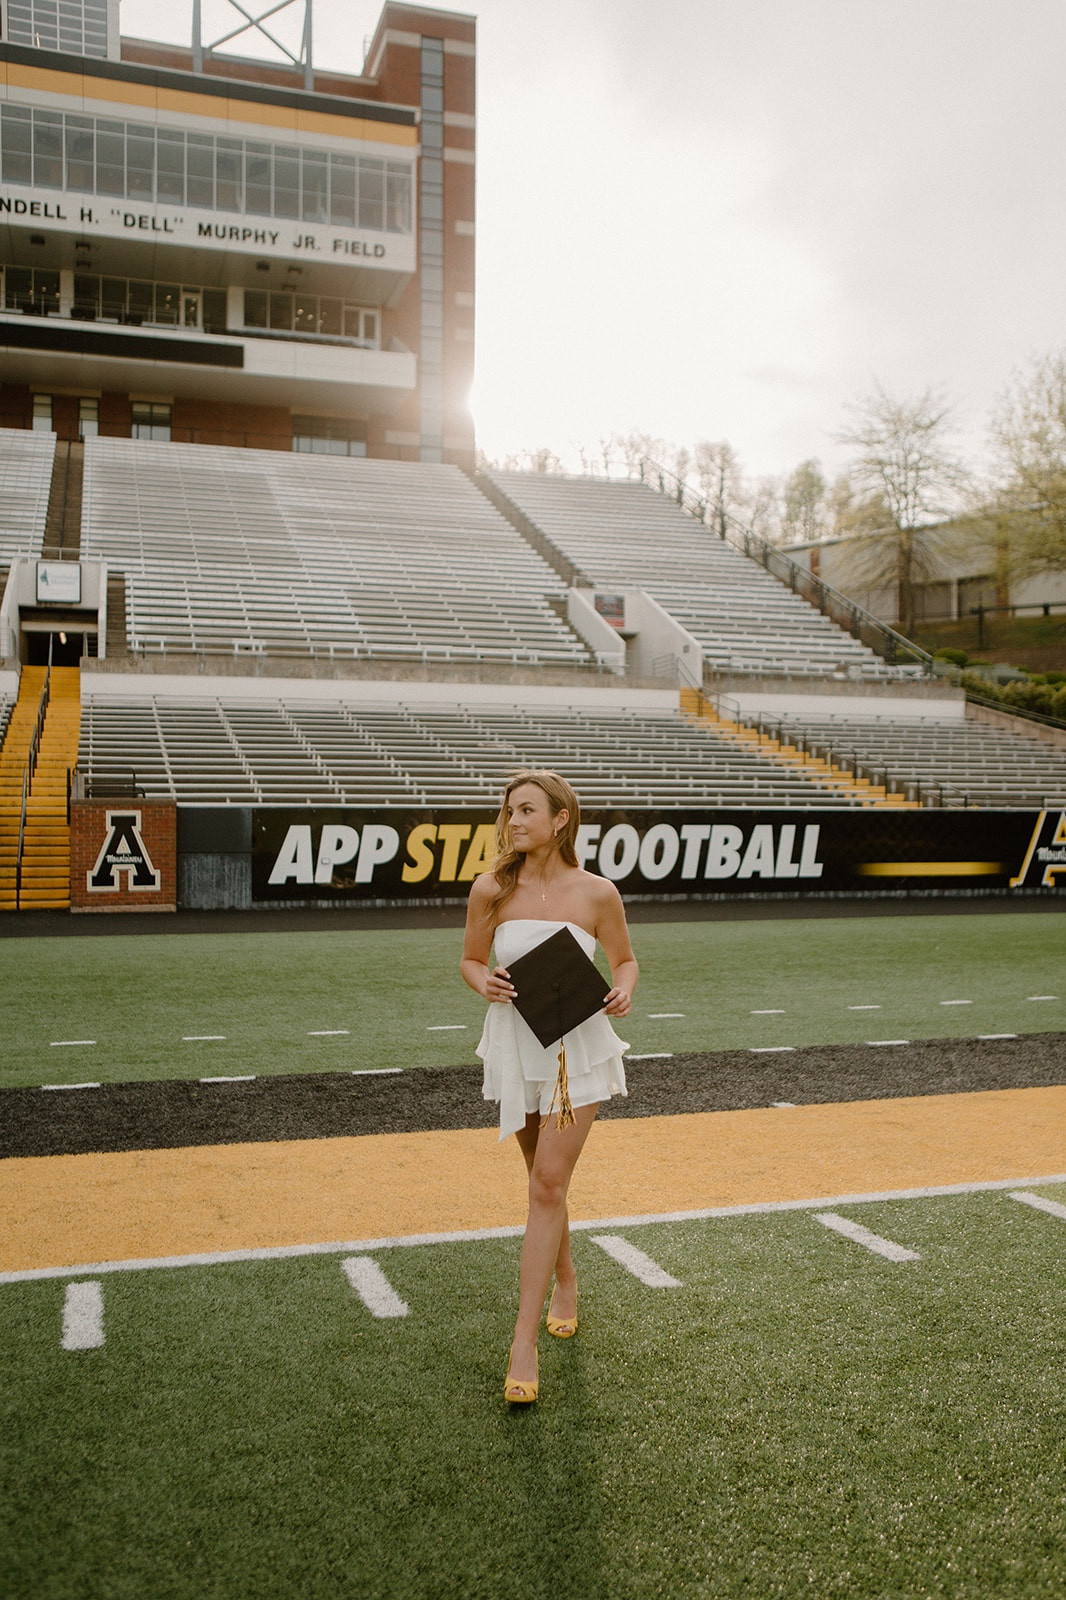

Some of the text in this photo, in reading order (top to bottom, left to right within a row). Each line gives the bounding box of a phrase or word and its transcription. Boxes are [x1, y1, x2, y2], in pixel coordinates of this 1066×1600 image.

[80, 207, 99, 223] H.
[197, 222, 280, 246] MURPHY
[293, 234, 321, 251] JR.
[333, 238, 386, 259] FIELD
[86, 809, 161, 892] A
[267, 823, 824, 885] APP STA FOOTBALL
